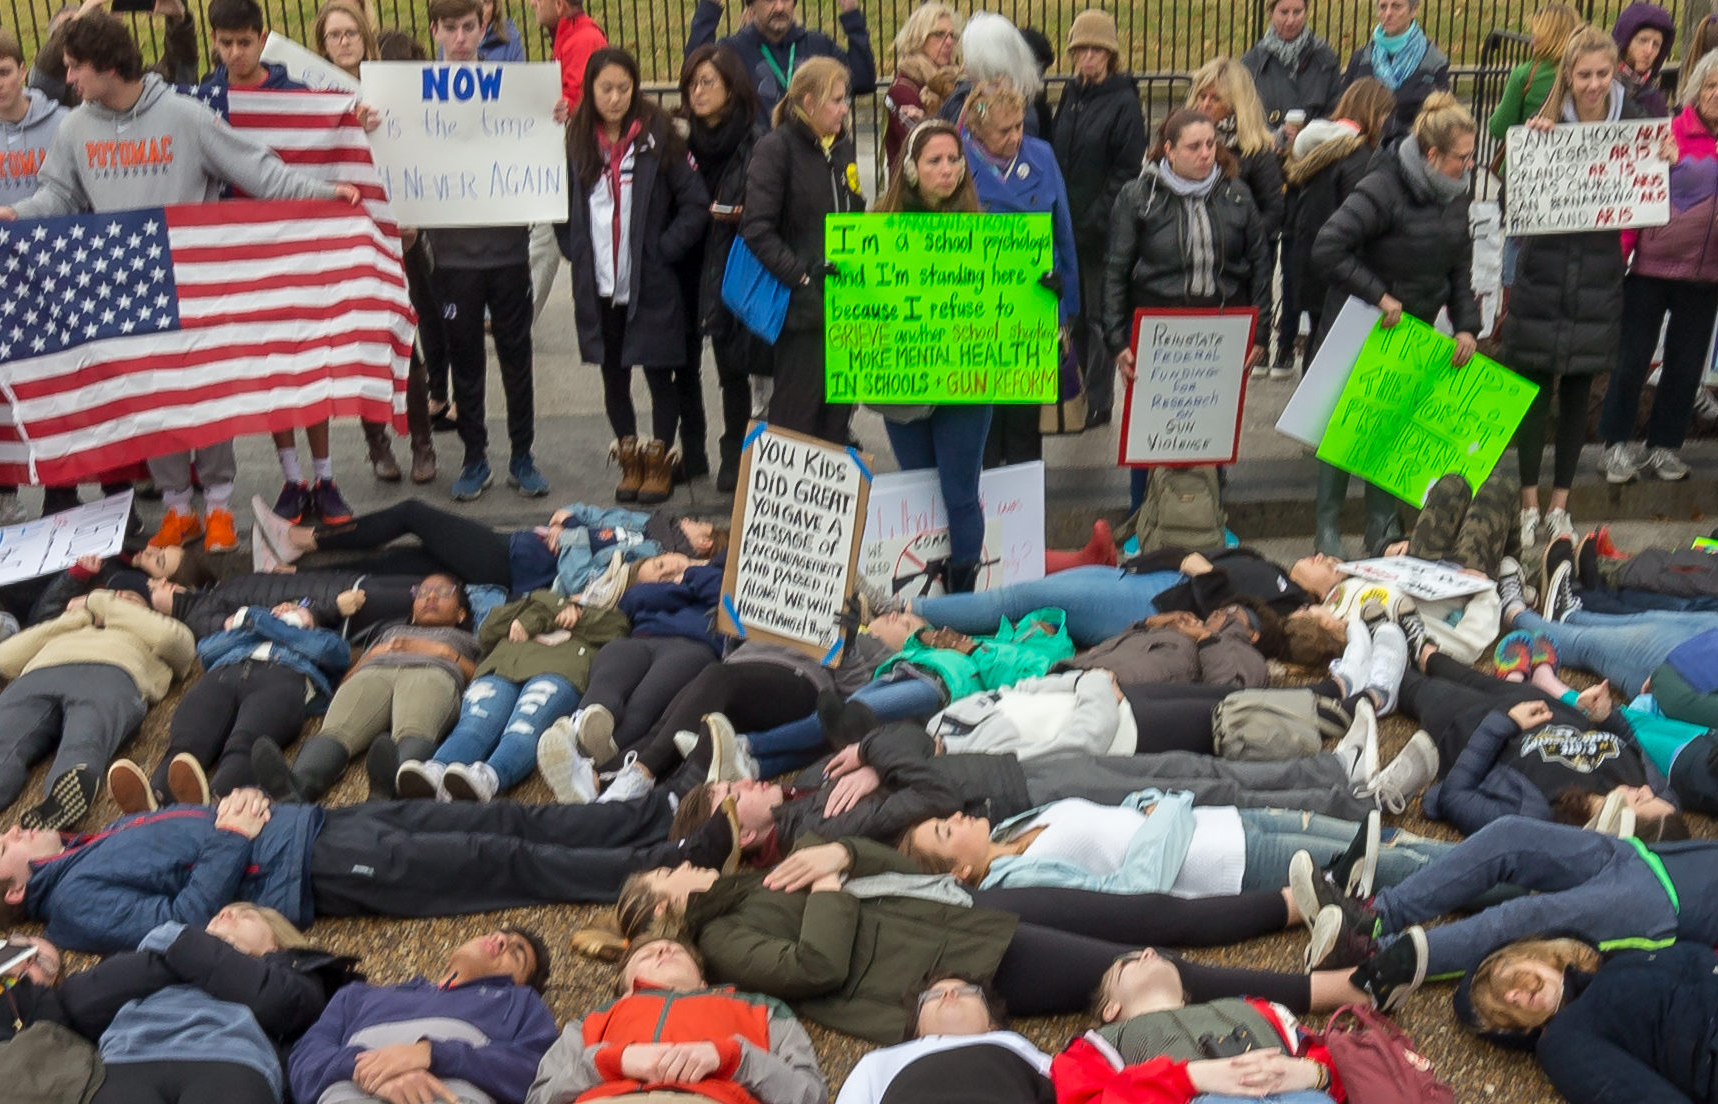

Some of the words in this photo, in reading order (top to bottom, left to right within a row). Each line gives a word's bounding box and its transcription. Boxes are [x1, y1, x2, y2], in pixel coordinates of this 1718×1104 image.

[422, 66, 504, 101] NOW
[424, 107, 457, 140] the
[482, 107, 537, 141] time
[85, 135, 174, 169] POTOMAC
[403, 165, 477, 201] NEVER
[489, 160, 561, 198] AGAIN
[831, 223, 879, 255] I'm
[895, 232, 909, 251] a
[924, 229, 973, 253] school
[832, 262, 866, 288] and
[875, 261, 910, 287] I'm
[919, 262, 985, 295] standing
[992, 262, 1027, 285] here
[831, 294, 899, 321] because
[903, 295, 923, 322] I
[930, 291, 986, 320] refuse
[995, 291, 1015, 318] to
[828, 322, 890, 352] GRIEVE
[894, 322, 946, 343] another
[952, 320, 1000, 342] school
[849, 345, 892, 372] MORE
[895, 343, 957, 367] MENTAL
[959, 341, 1041, 368] HEALTH
[831, 371, 856, 398] IN
[863, 370, 929, 395] SCHOOLS
[946, 371, 988, 395] GUN
[993, 368, 1057, 397] REFORM
[758, 434, 796, 469] YOU
[803, 448, 848, 482] KIDS
[754, 467, 788, 498] DID
[752, 493, 780, 519] YOU
[781, 503, 824, 534] GAVE
[827, 517, 842, 538] A
[745, 520, 817, 551] MESSAGE
[741, 556, 770, 579] AND
[784, 587, 806, 611] WE
